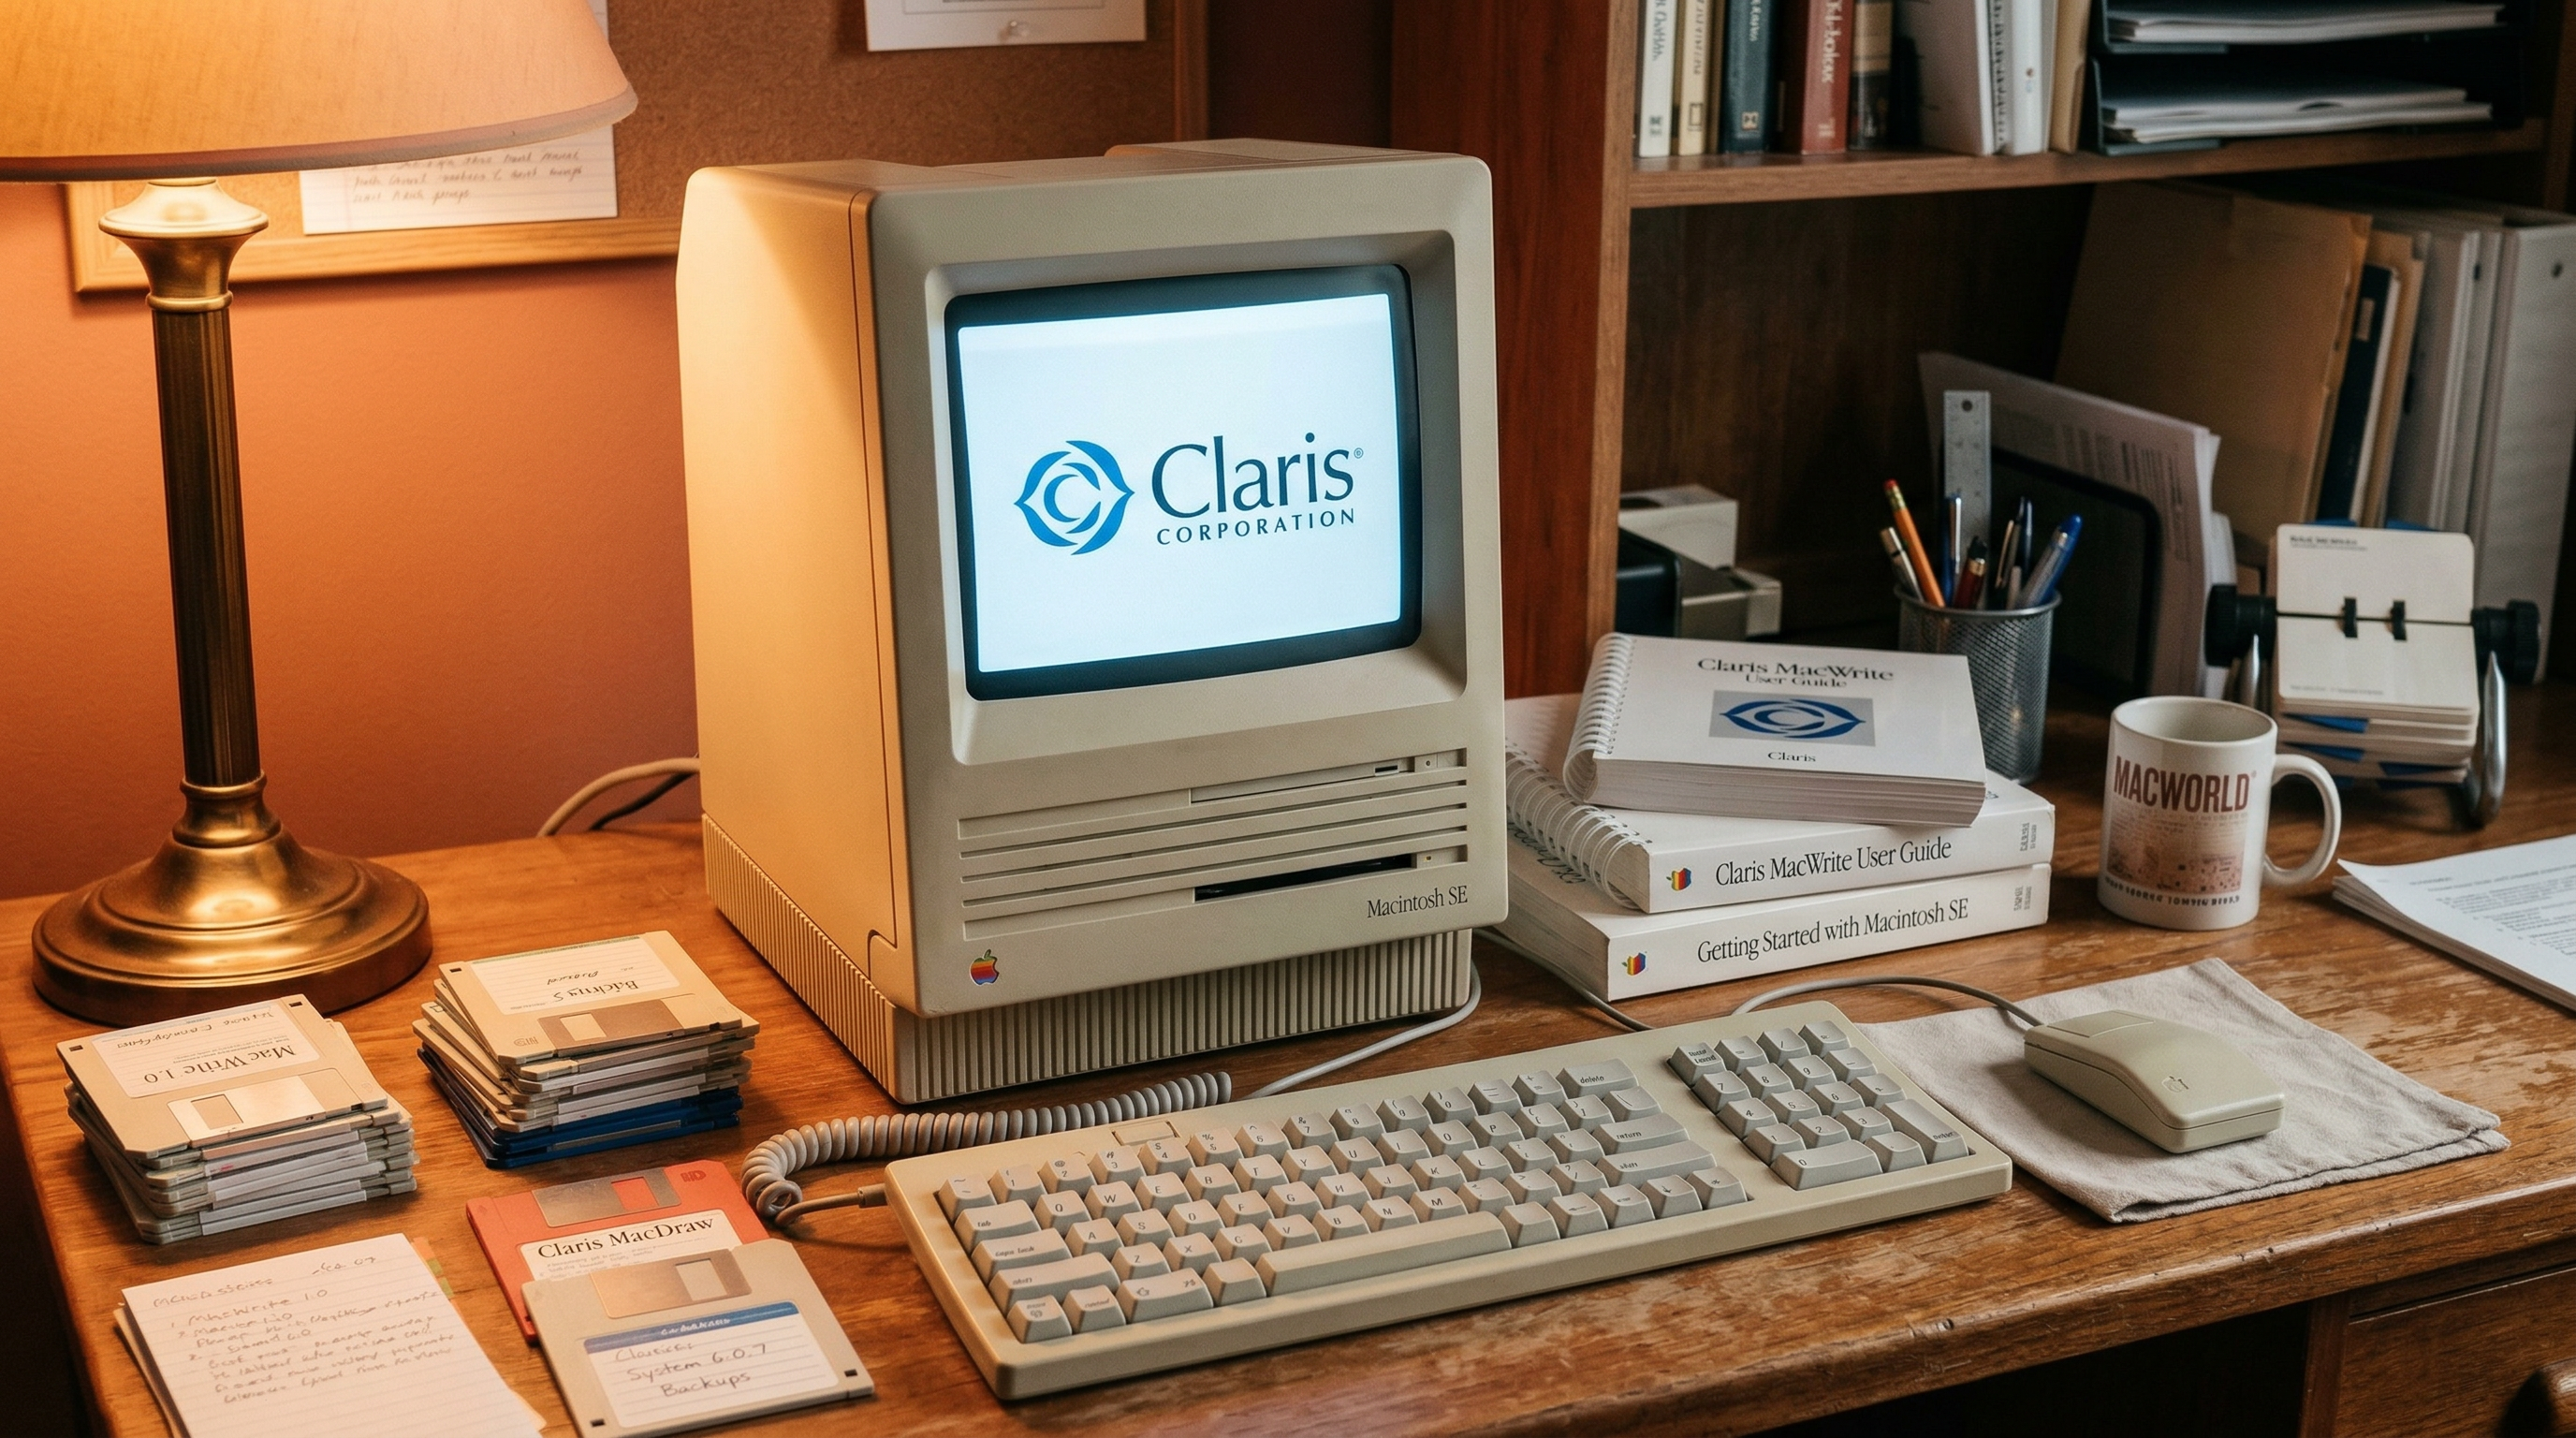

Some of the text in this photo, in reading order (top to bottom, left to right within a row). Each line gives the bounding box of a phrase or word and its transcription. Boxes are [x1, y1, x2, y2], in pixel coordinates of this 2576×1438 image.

[1157, 508, 1354, 545] CORPORATION
[1697, 658, 1895, 682] Claris MacWrite
[1746, 674, 1847, 688] User Guide
[1767, 752, 1816, 763] Claris
[1716, 837, 1952, 887] Claris MacWrite User Guide
[1367, 885, 1468, 918] Macintosh SE
[1697, 899, 1969, 963] Getting Started with Macintosh SE
[1717, 1082, 1724, 1091] 7
[1489, 1124, 1497, 1133] P
[1104, 1194, 1116, 1203] W
[538, 1218, 713, 1258] Claris MacDraw
[1088, 1231, 1096, 1240] A
[1138, 1222, 1146, 1230] S
[626, 1343, 766, 1383] System 6.0.7
[661, 1372, 751, 1397] Backups
